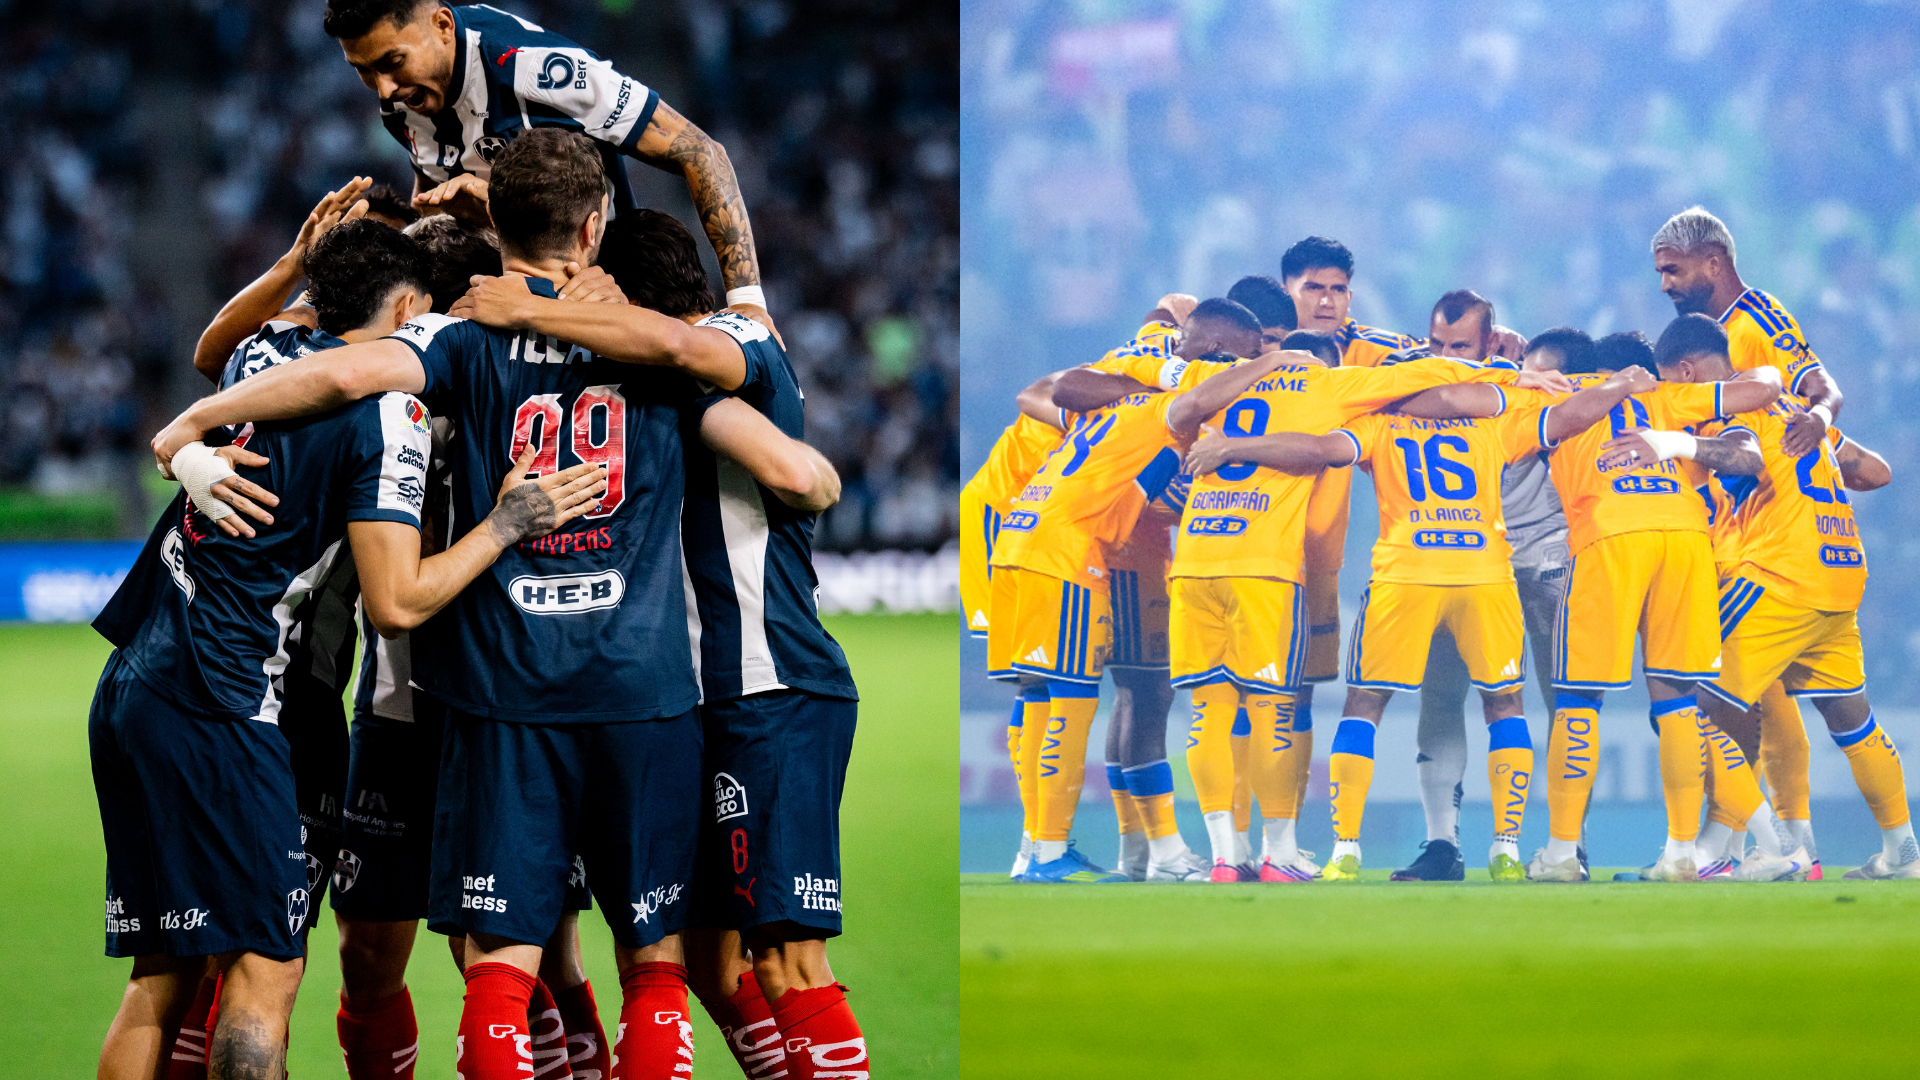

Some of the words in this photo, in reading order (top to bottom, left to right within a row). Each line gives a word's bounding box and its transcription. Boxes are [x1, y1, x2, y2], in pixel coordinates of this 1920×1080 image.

[603, 80, 632, 130] CREST
[1215, 397, 1271, 481] 8
[1394, 433, 1477, 502] 16
[1409, 509, 1424, 523] D.
[1425, 507, 1485, 523] LAINEZ
[1421, 532, 1479, 545] H-E-B
[522, 578, 613, 606] H-E-B
[1563, 717, 1592, 780] viva
[715, 786, 737, 804] OLLO
[1504, 770, 1530, 833] viva
[717, 800, 738, 819] OCO
[288, 849, 306, 862] Hospi
[730, 827, 749, 875] 8
[793, 872, 838, 896] plan
[802, 890, 843, 914] fitn
[160, 909, 181, 930] rl's
[182, 907, 208, 930] Jr.
